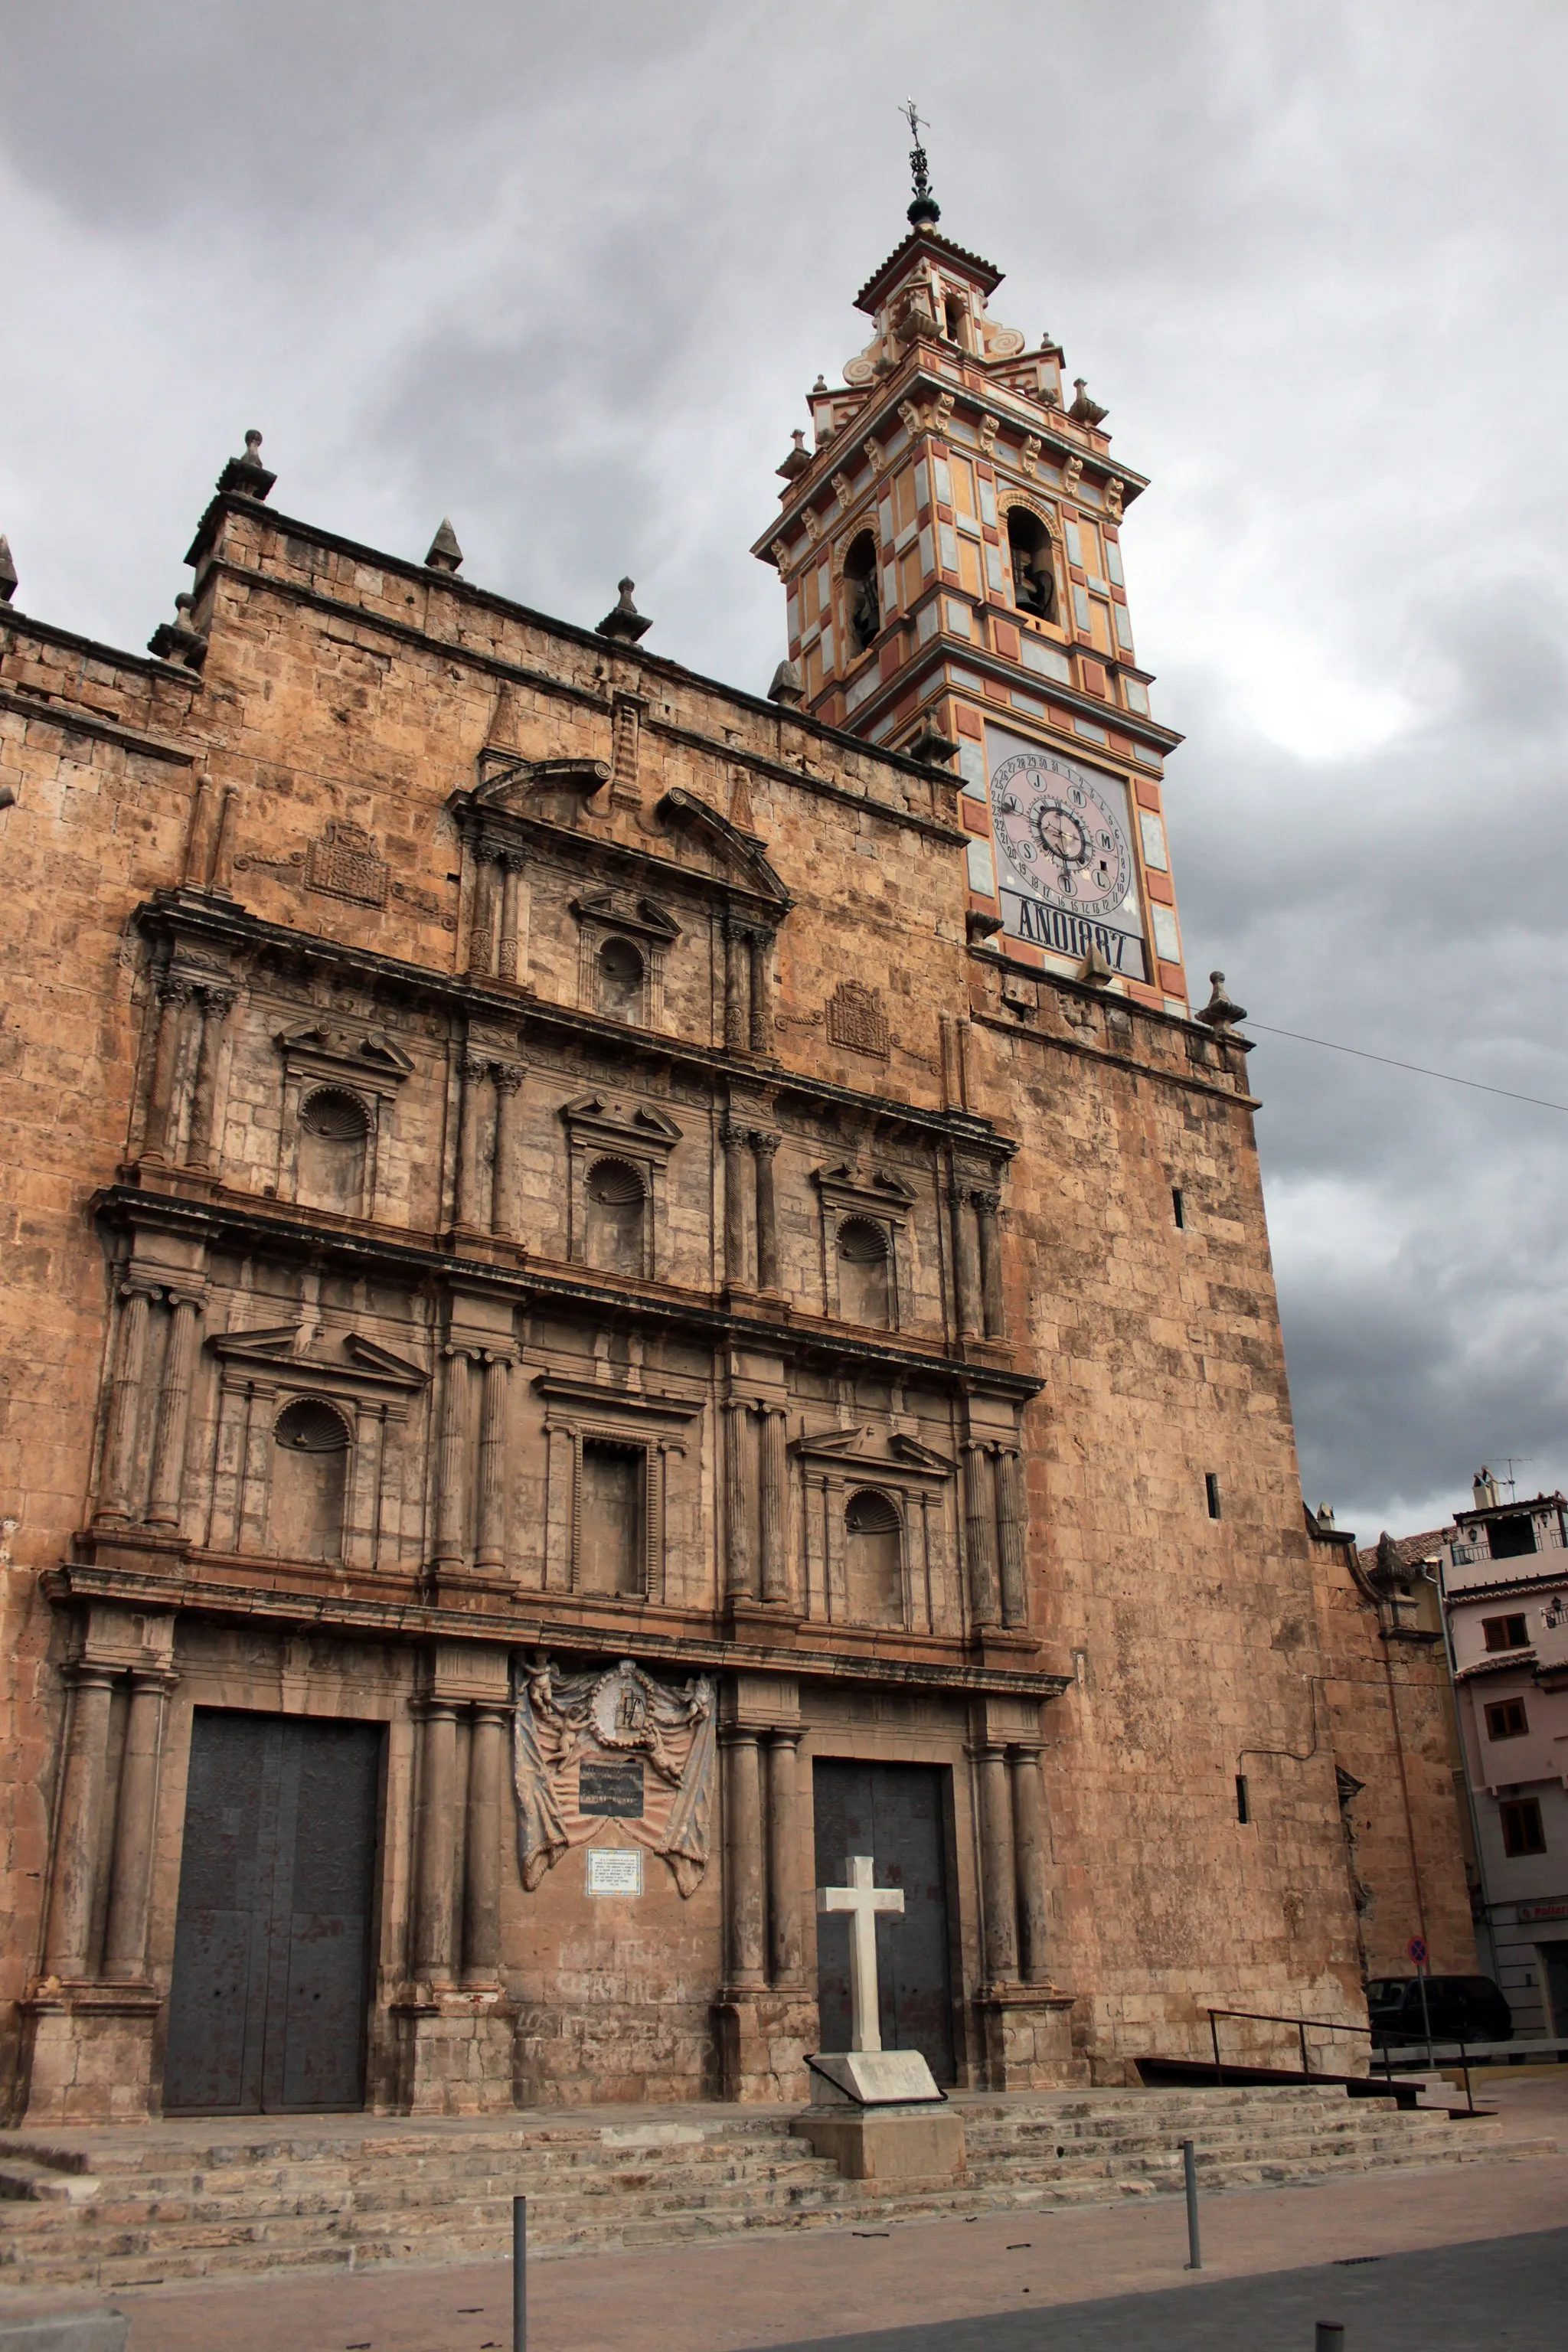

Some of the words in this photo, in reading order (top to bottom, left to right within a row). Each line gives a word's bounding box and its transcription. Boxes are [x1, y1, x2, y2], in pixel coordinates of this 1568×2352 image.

[1008, 762, 1015, 773] 27
[1017, 758, 1025, 769] 28
[1027, 756, 1036, 767] 29
[1038, 756, 1047, 769] 30
[1051, 760, 1058, 773] 31
[1000, 769, 1008, 780] 26
[1034, 774, 1040, 787] J
[995, 778, 1004, 789] 25
[1073, 789, 1081, 805] M
[1010, 796, 1017, 811] V
[992, 805, 1001, 817] 23
[995, 818, 1004, 831] 22
[1000, 832, 1008, 844] 21
[1102, 834, 1110, 849] M
[1008, 846, 1017, 859] 20
[1024, 843, 1031, 858] S
[1019, 862, 1026, 875] 19
[1031, 876, 1038, 889] 18
[1063, 877, 1070, 893] D
[1097, 872, 1106, 888] L
[1043, 886, 1050, 897] 17
[1117, 883, 1124, 893] 10
[1058, 896, 1065, 907] 16
[1112, 891, 1118, 903] 11
[1071, 901, 1078, 912] 15
[1093, 903, 1099, 913] 13
[1102, 900, 1110, 911] 12
